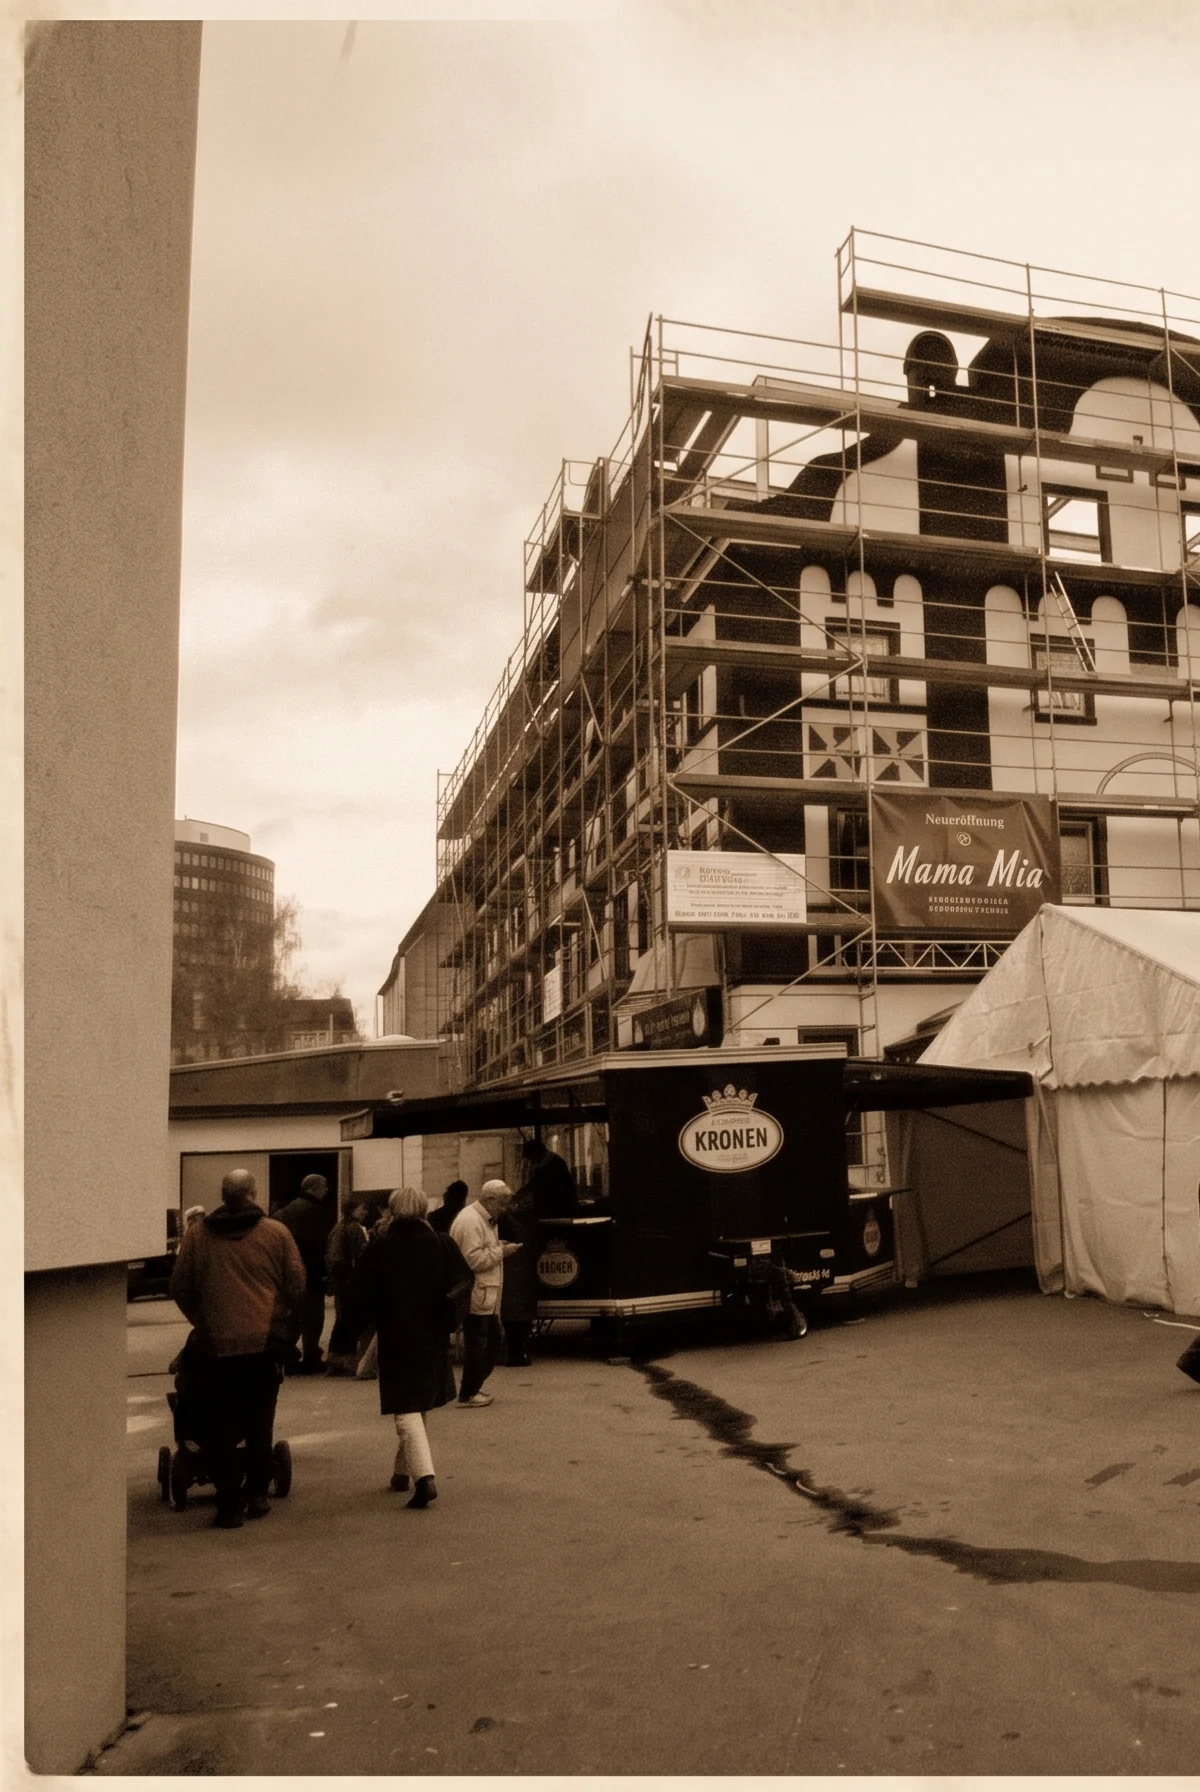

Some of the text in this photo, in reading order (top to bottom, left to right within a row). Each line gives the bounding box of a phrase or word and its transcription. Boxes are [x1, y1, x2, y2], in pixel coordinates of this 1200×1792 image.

[925, 813, 1005, 829] Neueröffnung
[886, 845, 1044, 889] Mama Mia
[695, 1127, 768, 1152] KRONEN
